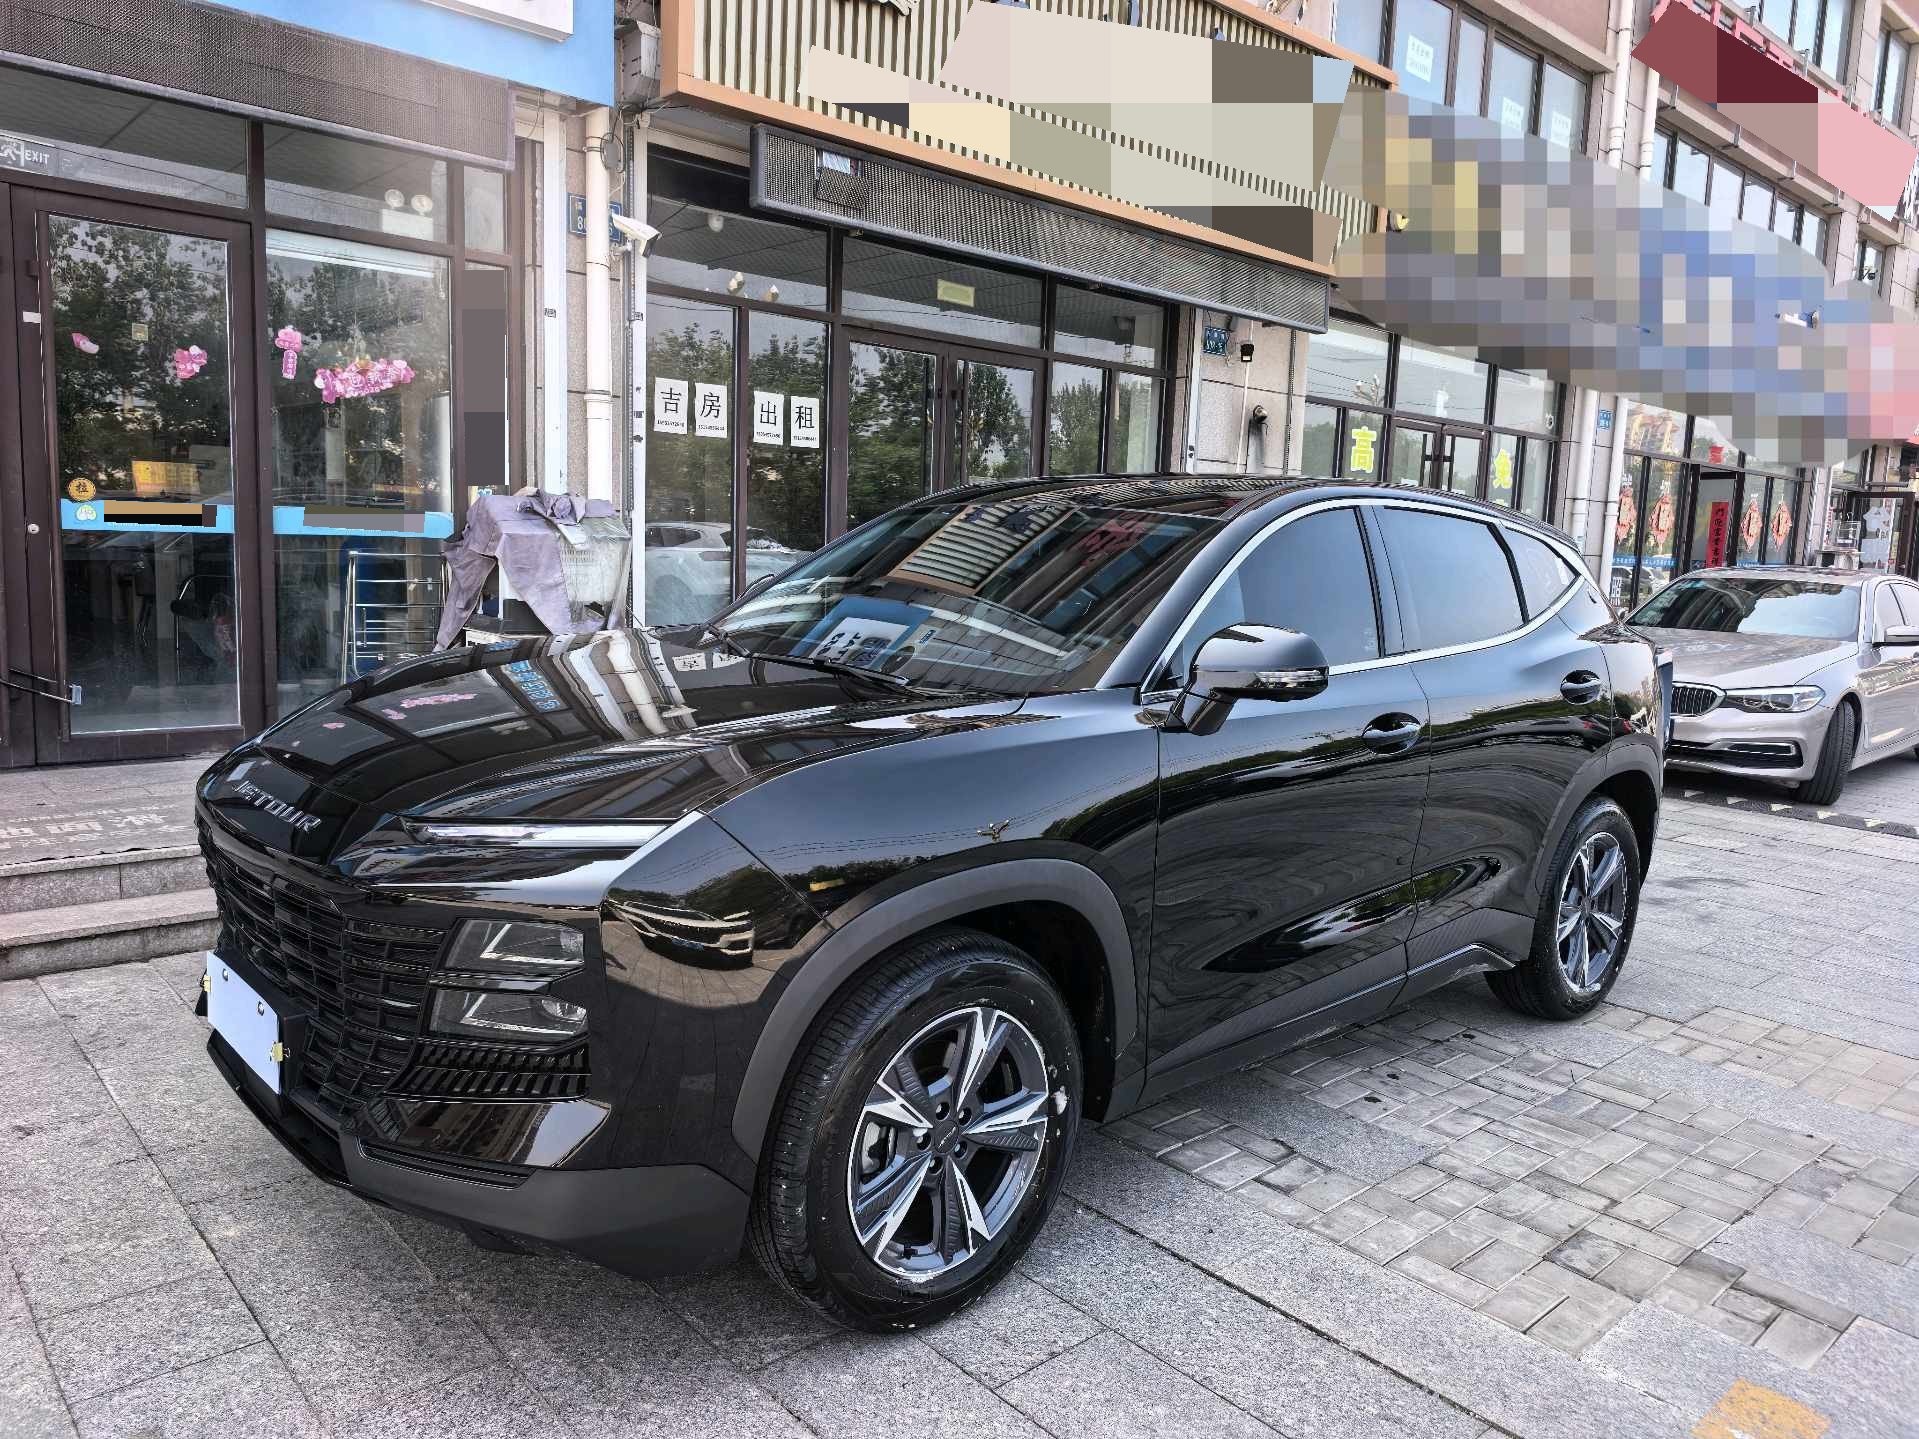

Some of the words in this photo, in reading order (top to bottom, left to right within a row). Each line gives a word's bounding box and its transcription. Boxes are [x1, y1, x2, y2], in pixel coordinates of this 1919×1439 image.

[24, 149, 50, 165] EXIT
[660, 387, 682, 414] 吉
[699, 391, 721, 418] 房
[759, 400, 777, 427] 出
[794, 405, 815, 430] 租
[231, 780, 323, 832] JETOUR
